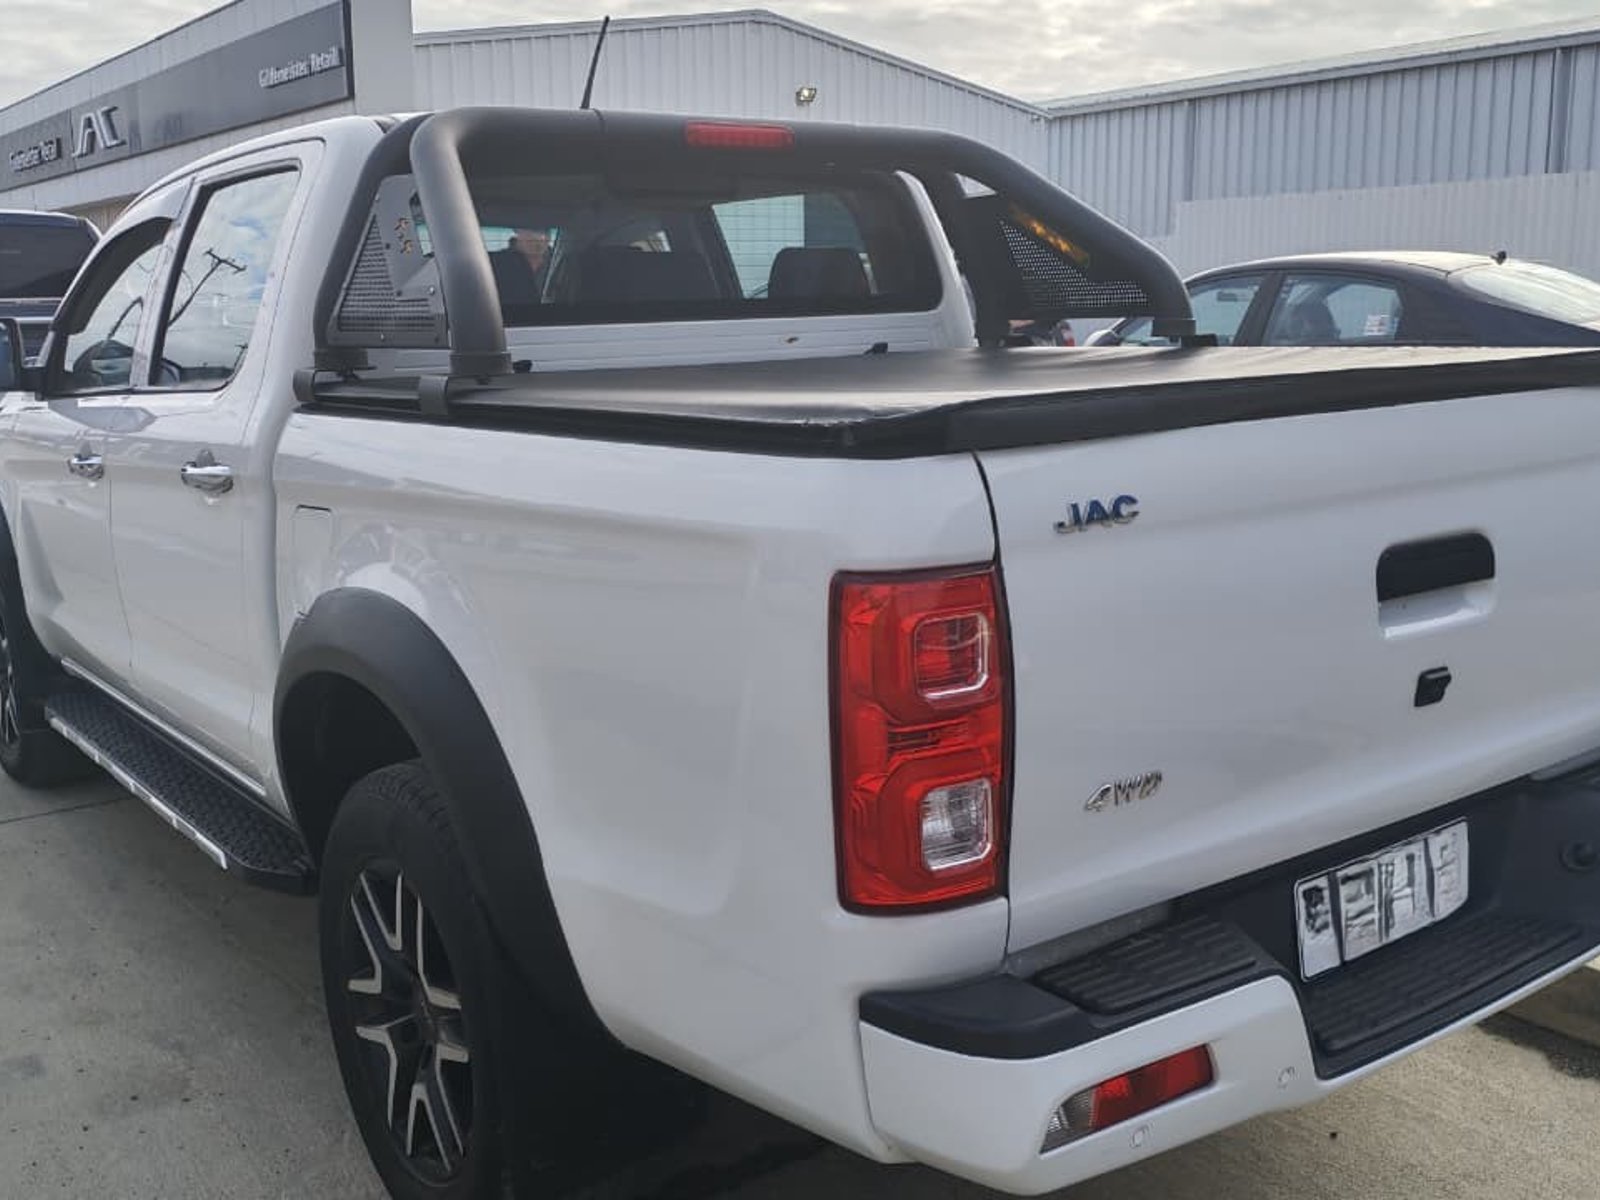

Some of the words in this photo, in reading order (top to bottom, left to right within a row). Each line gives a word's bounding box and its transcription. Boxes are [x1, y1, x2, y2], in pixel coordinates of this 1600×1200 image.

[71, 105, 126, 159] JAC
[1053, 494, 1140, 534] JAC
[1084, 771, 1163, 813] 4WD
